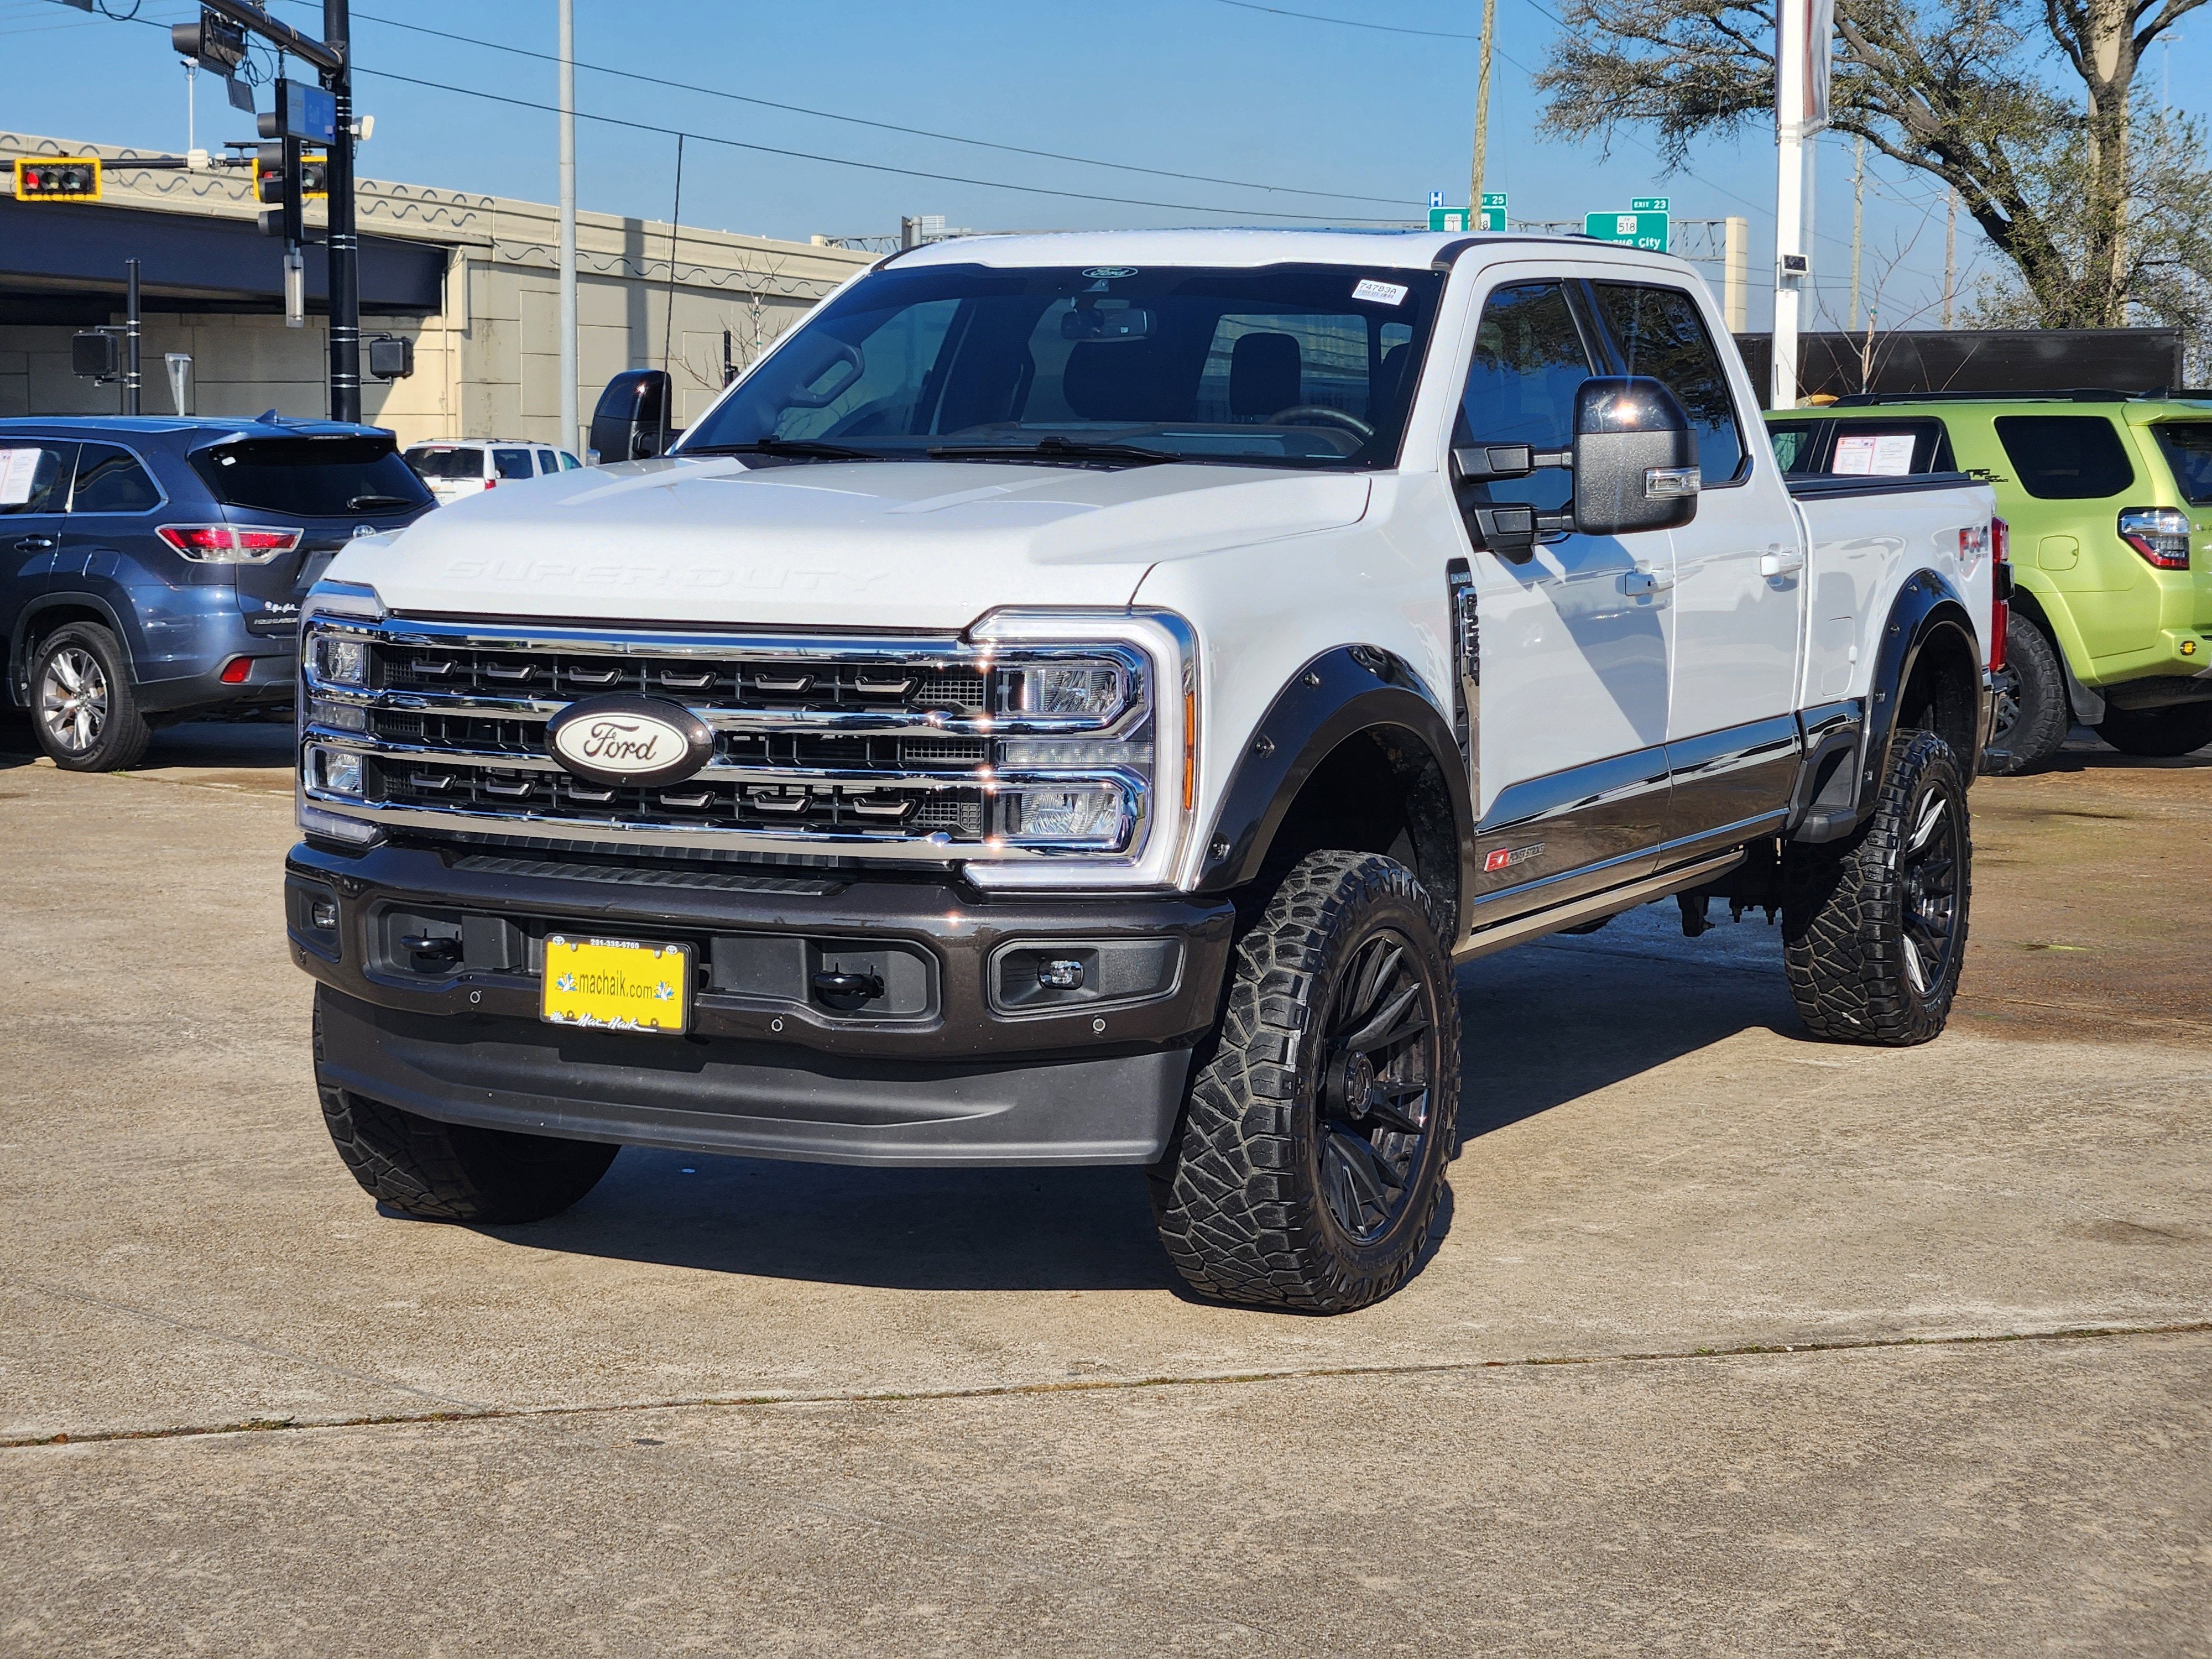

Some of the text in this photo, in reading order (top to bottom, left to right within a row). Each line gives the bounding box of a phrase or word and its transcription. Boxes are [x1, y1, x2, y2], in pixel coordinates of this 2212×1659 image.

[1492, 196, 1504, 205] 25
[1653, 200, 1666, 209] 23
[1619, 222, 1636, 232] 518
[1639, 237, 1661, 250] City
[1360, 283, 1396, 294] 74783A
[1959, 526, 1988, 561] FX4
[443, 560, 890, 591] SUPER DUTY
[583, 722, 659, 761] Ford
[579, 969, 653, 999] machaik.com
[577, 1013, 607, 1027] Mac
